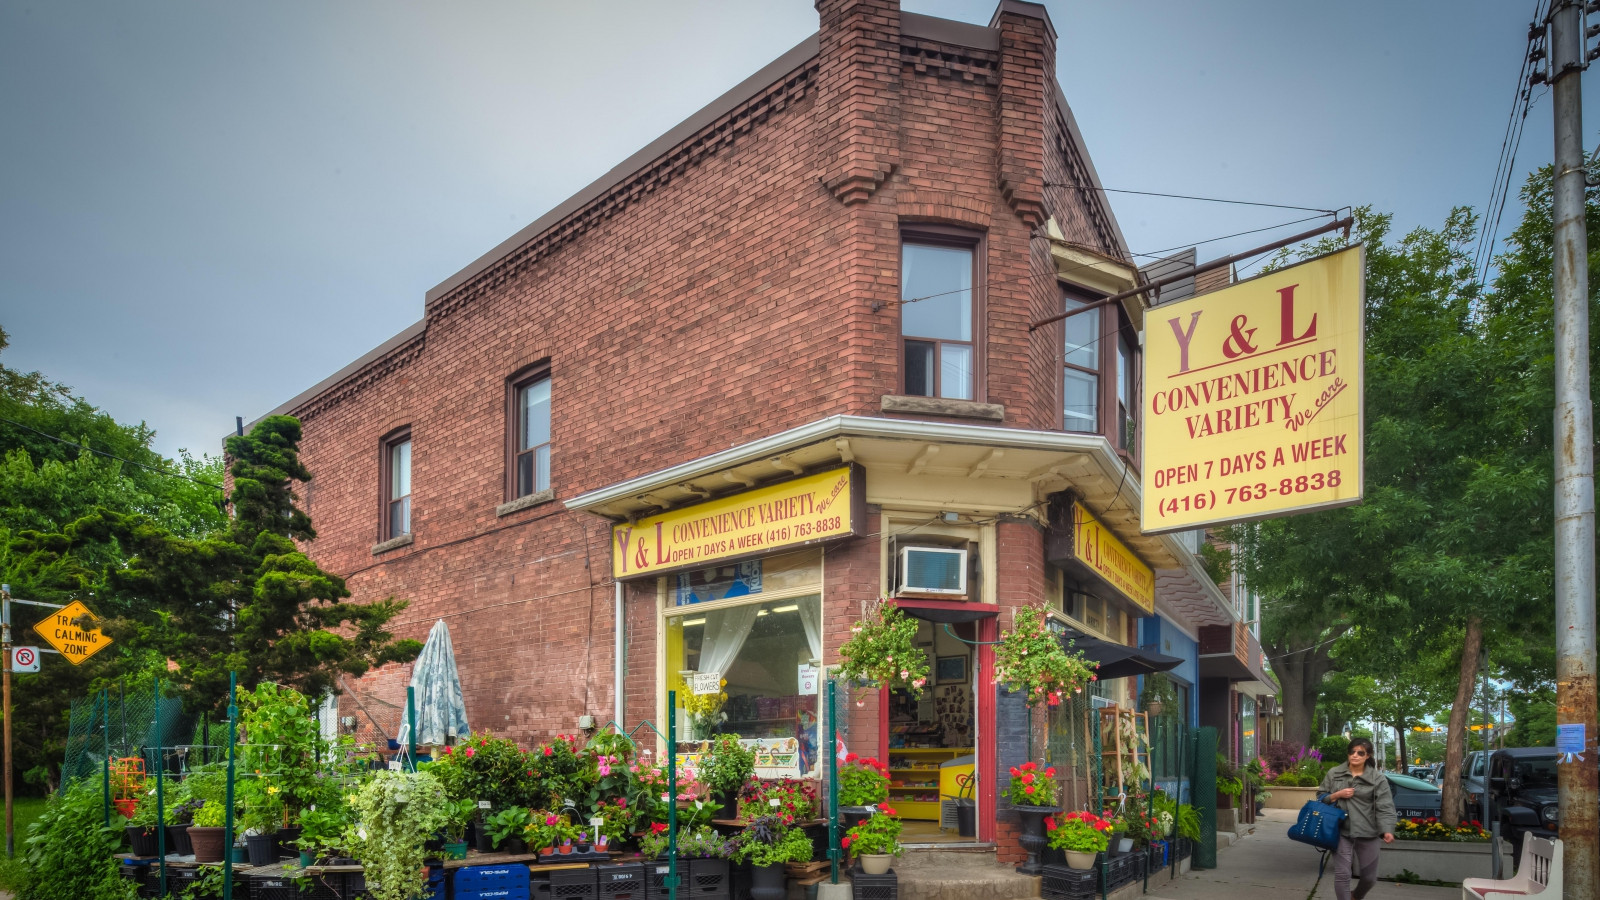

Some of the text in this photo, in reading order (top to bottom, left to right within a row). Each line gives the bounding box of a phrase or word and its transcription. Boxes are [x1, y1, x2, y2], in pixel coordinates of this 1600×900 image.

[1168, 283, 1317, 372] Y & L
[1152, 349, 1336, 415] CONVENIENCE
[1285, 376, 1343, 432] We care
[1185, 393, 1297, 439] VARIETY
[1154, 434, 1347, 489] OPEN 7 DAYS A WEEK
[815, 475, 846, 514] We care
[1158, 469, 1342, 517] (416) 763-8838
[672, 516, 841, 562] OPEN 7 DAYS A WEEK (416) 763-8838
[673, 492, 816, 544] CONVENIENCE VARIETY
[1075, 505, 1083, 556] Y
[1095, 525, 1103, 571] L
[616, 521, 671, 573] Y & L
[55, 628, 98, 643] CALMING
[63, 643, 88, 656] ZONE
[695, 681, 719, 691] FLOWERS
[1406, 809, 1423, 817] Litter
